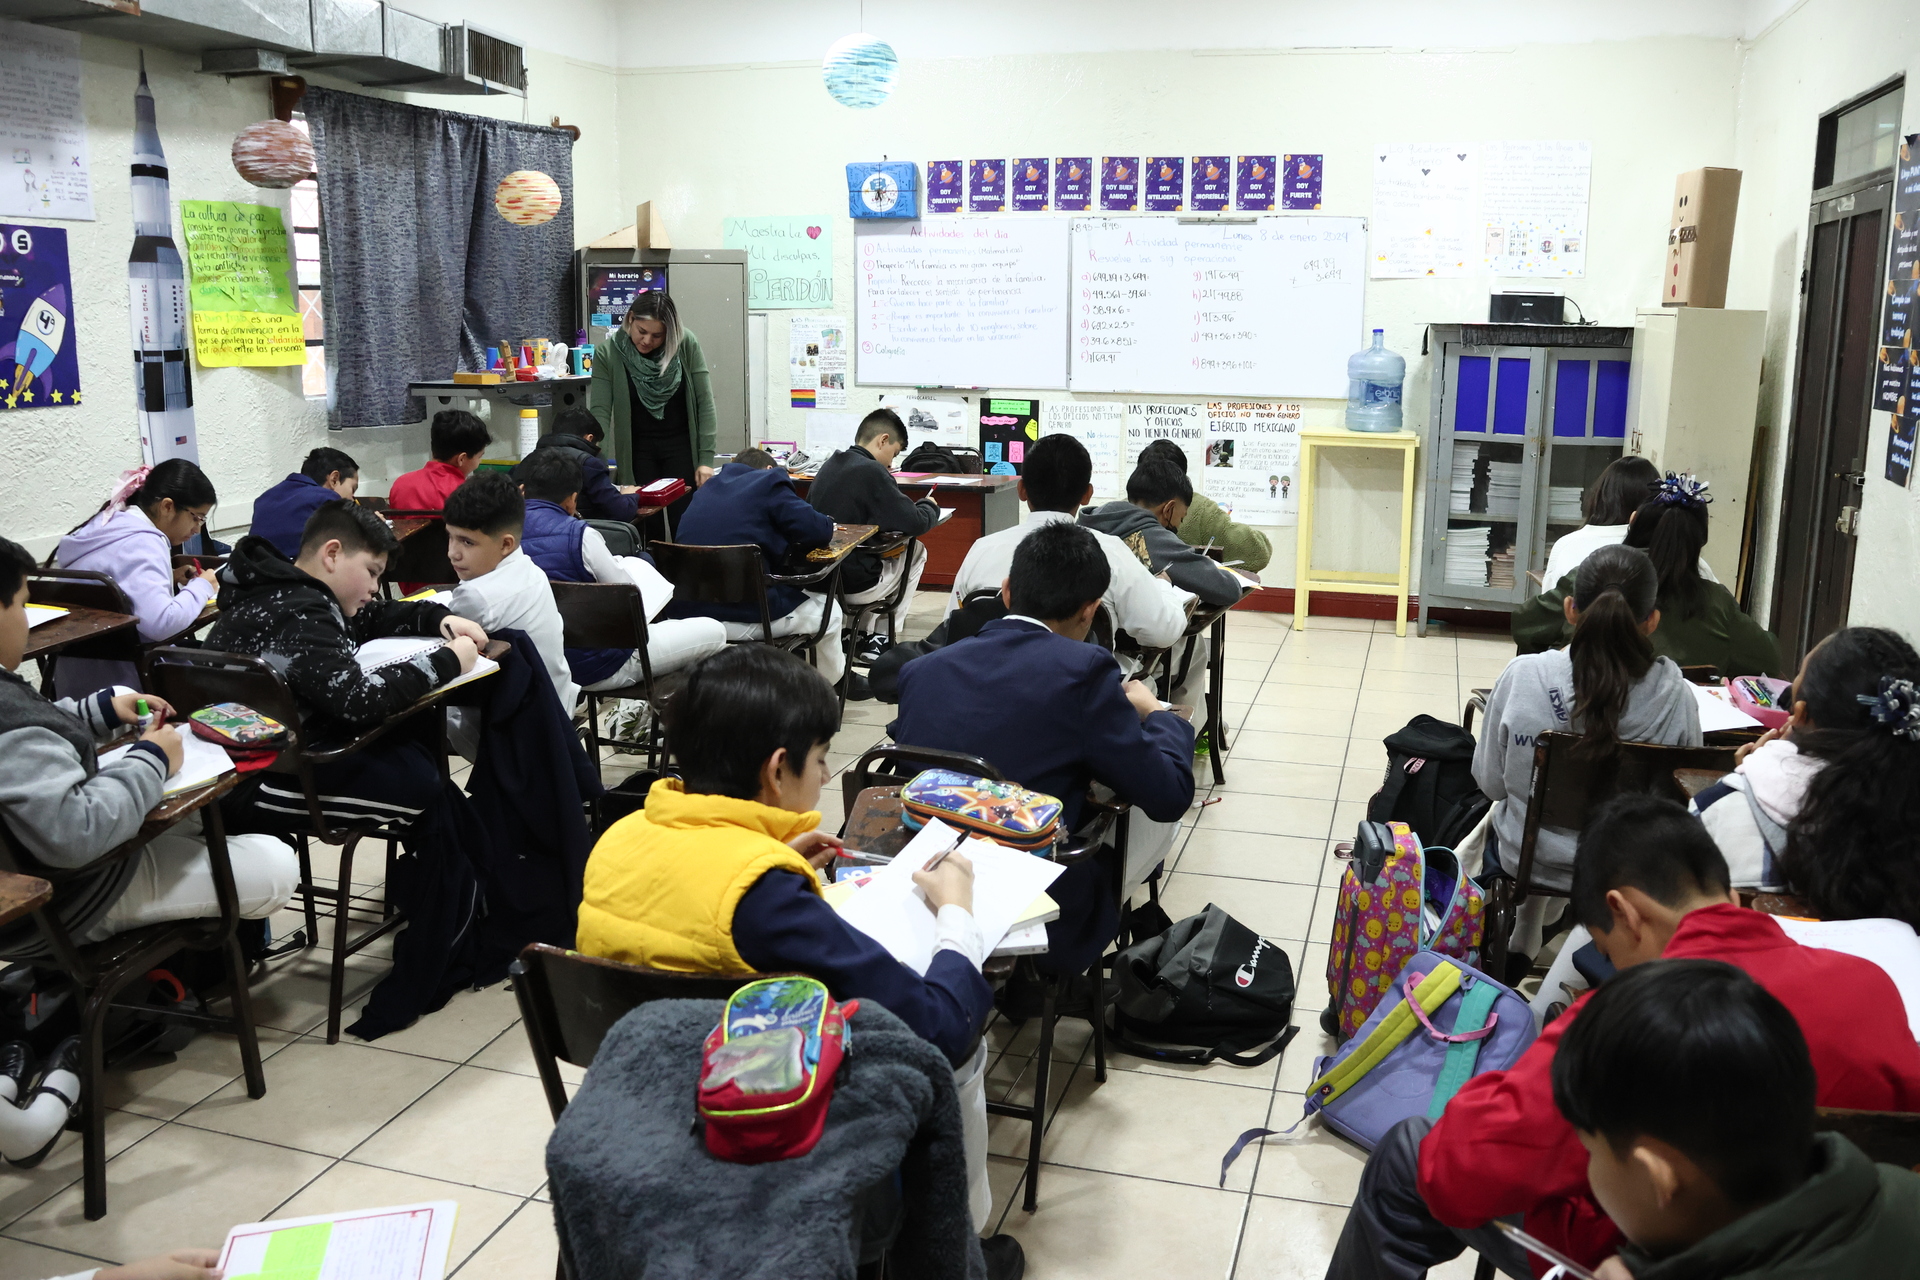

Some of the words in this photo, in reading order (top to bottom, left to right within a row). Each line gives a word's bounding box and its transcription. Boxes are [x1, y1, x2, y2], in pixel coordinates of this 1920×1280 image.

[183, 204, 195, 218] La
[199, 204, 226, 222] cultura
[250, 212, 266, 226] paz
[729, 220, 786, 238] Maestra
[910, 226, 964, 239] Actividades
[974, 228, 988, 239] del
[1223, 226, 1252, 241] Lunes
[1260, 229, 1267, 241] 8
[1272, 230, 1284, 241] de
[1324, 231, 1348, 242] 2024
[1125, 232, 1178, 247] Actividad
[1185, 240, 1242, 252] permanente
[877, 243, 922, 254] Actividades
[930, 247, 976, 257] permanentes
[1089, 250, 1131, 262] Resuelve
[1140, 255, 1152, 263] las
[1161, 256, 1174, 268] sig
[1184, 254, 1236, 266] operaciones
[922, 260, 946, 270] familia
[972, 263, 987, 272] gran
[937, 275, 943, 285] la
[992, 275, 1000, 283] de
[1006, 274, 1012, 282] la
[926, 288, 932, 296] el
[967, 288, 976, 296] de
[936, 298, 951, 308] parte
[957, 298, 965, 306] de
[970, 298, 976, 307] la
[968, 309, 974, 318] la
[198, 326, 218, 334] forma
[221, 327, 229, 335] de
[292, 324, 299, 333] la
[889, 323, 918, 333] Escribe
[932, 323, 951, 333] texto
[956, 324, 964, 332] de
[1017, 322, 1038, 331] sobre
[267, 336, 304, 344] solidaridad
[977, 334, 985, 342] las
[234, 344, 254, 354] entre
[1062, 404, 1106, 412] PROFESIONES
[1128, 405, 1142, 414] LAS
[1146, 405, 1197, 418] PROFECIONES
[1207, 402, 1222, 410] LAS
[1228, 402, 1272, 410] PROFESIONES
[1144, 417, 1151, 426] Y
[1154, 418, 1182, 426] OFICIOS
[1210, 420, 1246, 432] EJÉRCITO
[1254, 422, 1296, 433] MEXICANO
[1129, 429, 1140, 438] NO
[1144, 428, 1168, 438] TIENEN
